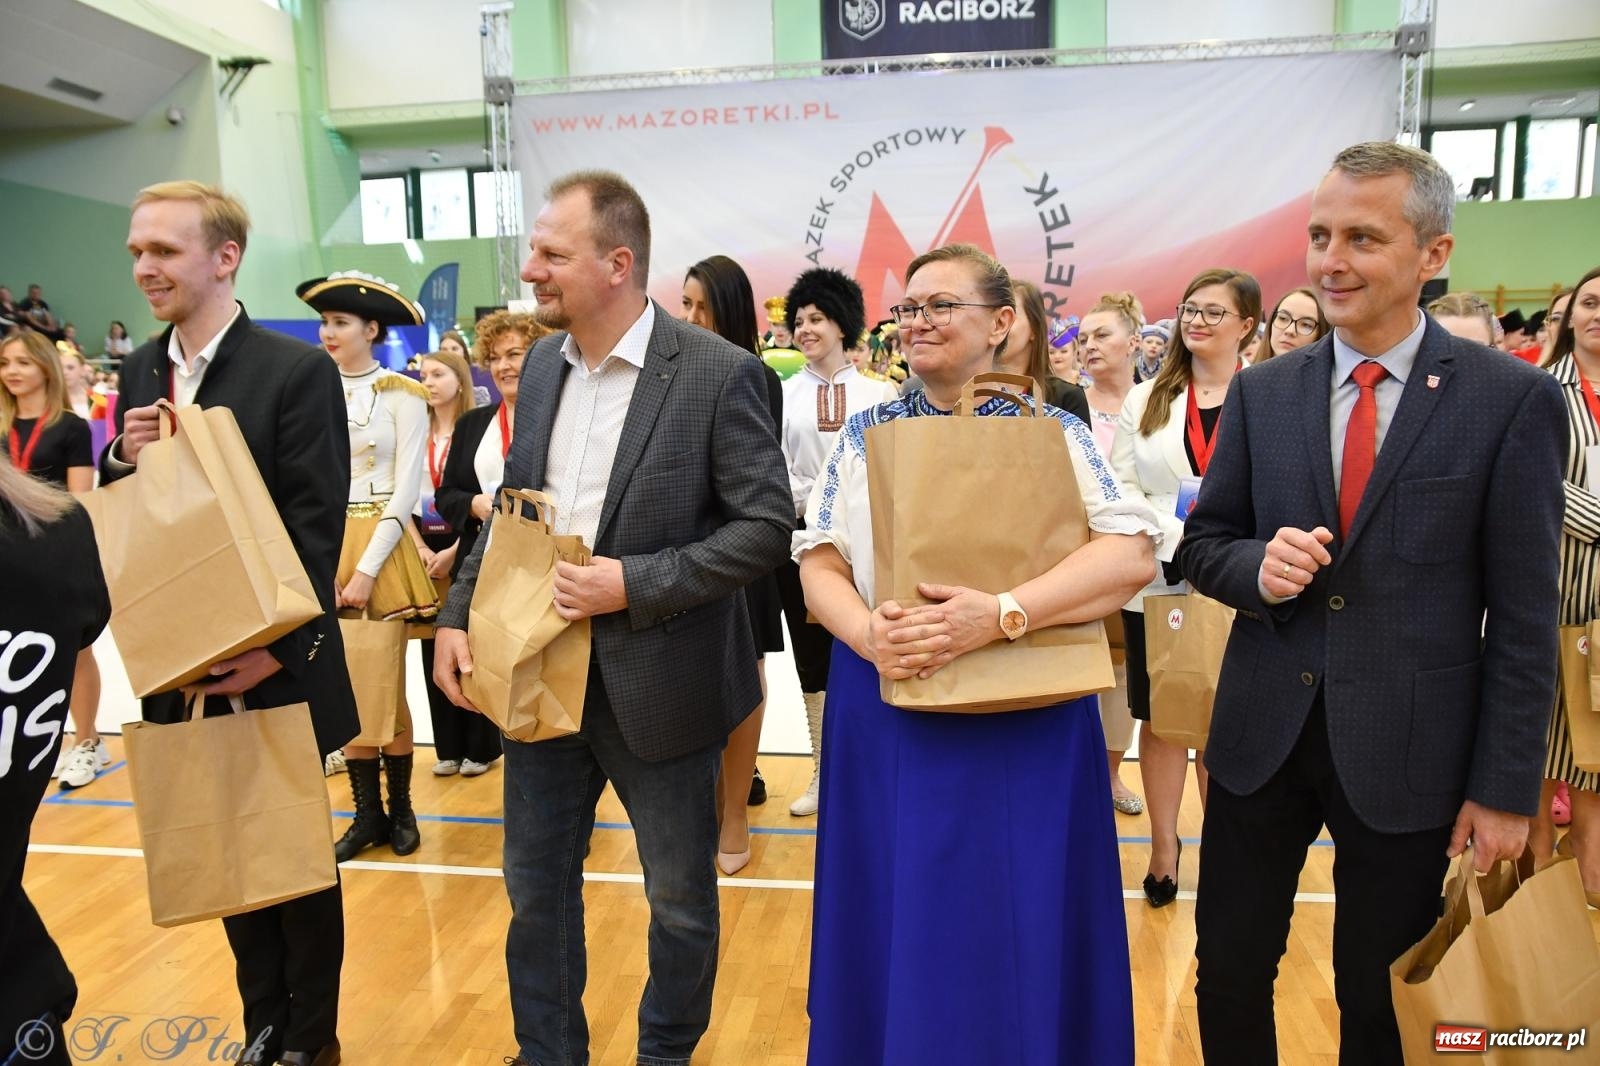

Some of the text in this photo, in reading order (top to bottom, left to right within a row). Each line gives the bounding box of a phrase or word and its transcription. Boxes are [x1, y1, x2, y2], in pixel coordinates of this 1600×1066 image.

[531, 101, 840, 135] WWW.MAZORETKI.PL
[830, 126, 967, 193] SPORTOWY
[1023, 170, 1075, 320] RETEK
[0, 630, 56, 694] O
